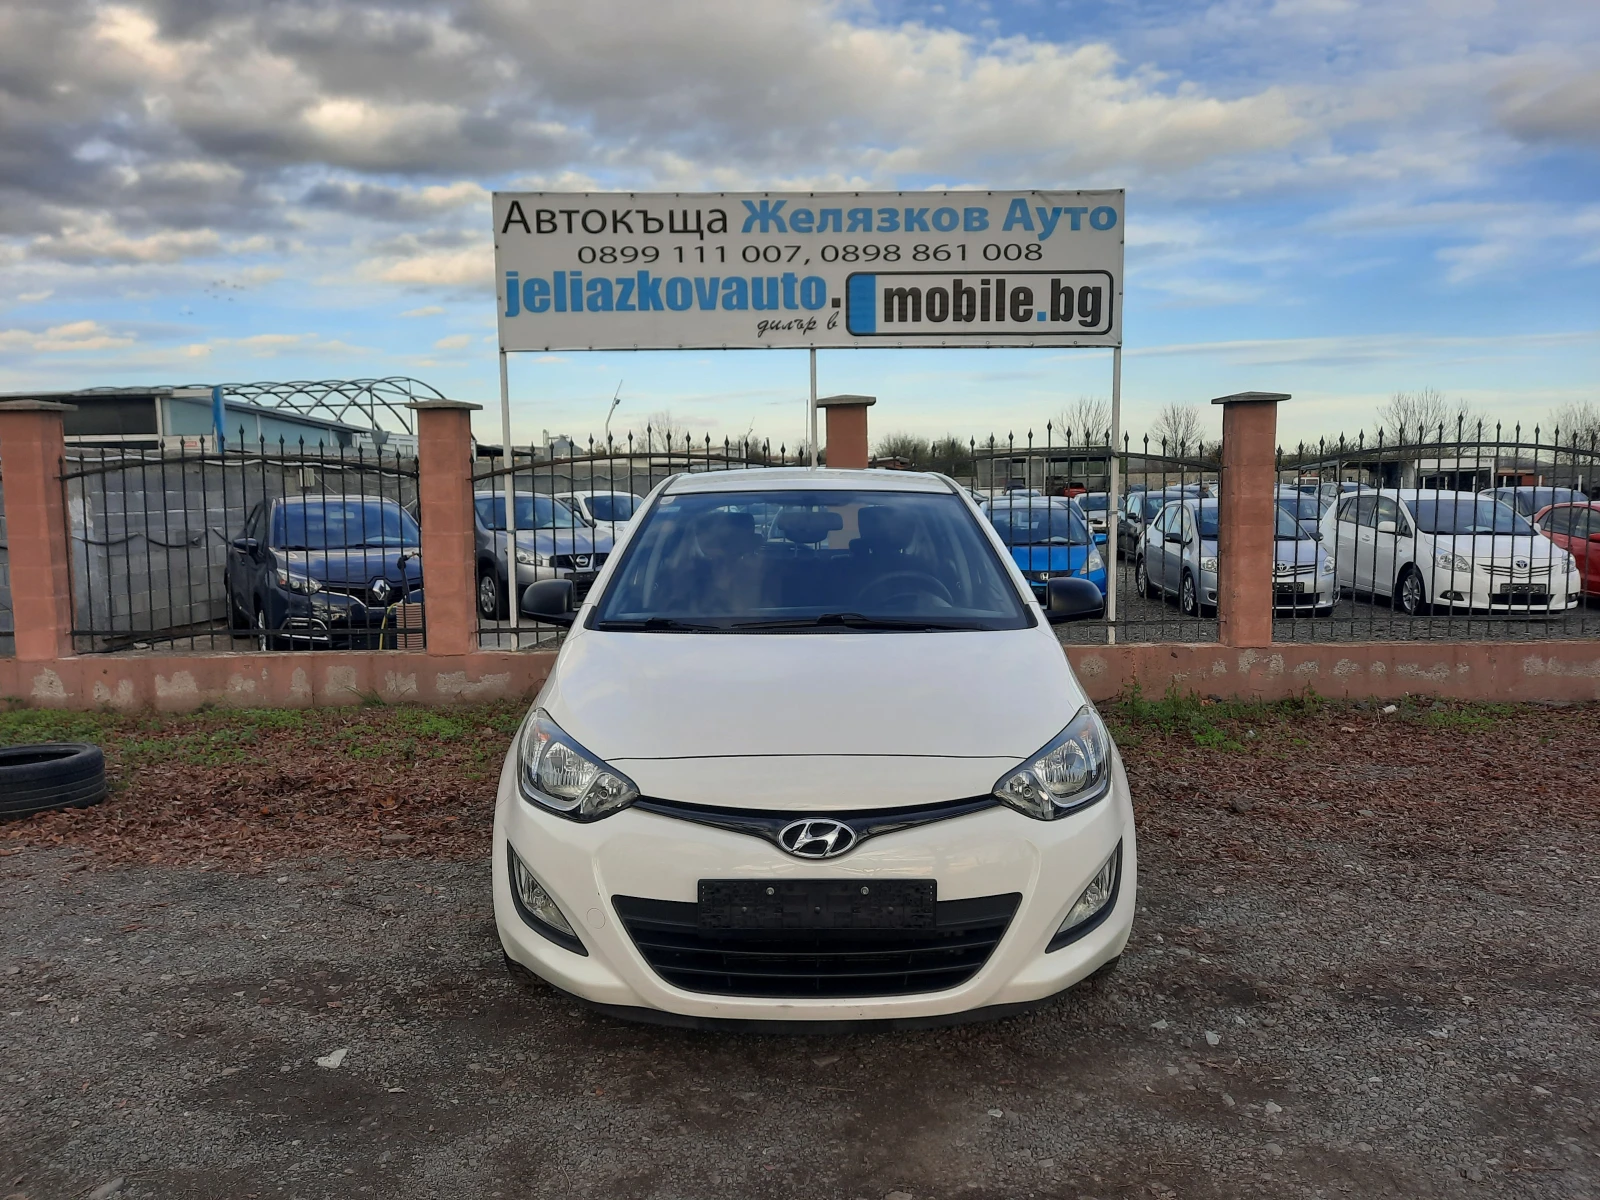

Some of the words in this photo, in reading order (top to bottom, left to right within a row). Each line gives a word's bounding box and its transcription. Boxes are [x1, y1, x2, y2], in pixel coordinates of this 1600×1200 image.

[501, 200, 728, 241] Автокъща
[741, 199, 990, 233] Желязков
[1002, 198, 1118, 241] Ауто
[577, 246, 660, 264] 0899
[673, 246, 725, 264] 111
[741, 245, 811, 266] 007,
[820, 244, 901, 263] 0898
[911, 243, 966, 262] 861
[982, 243, 1043, 261] 008
[883, 277, 1103, 328] mobile.bg
